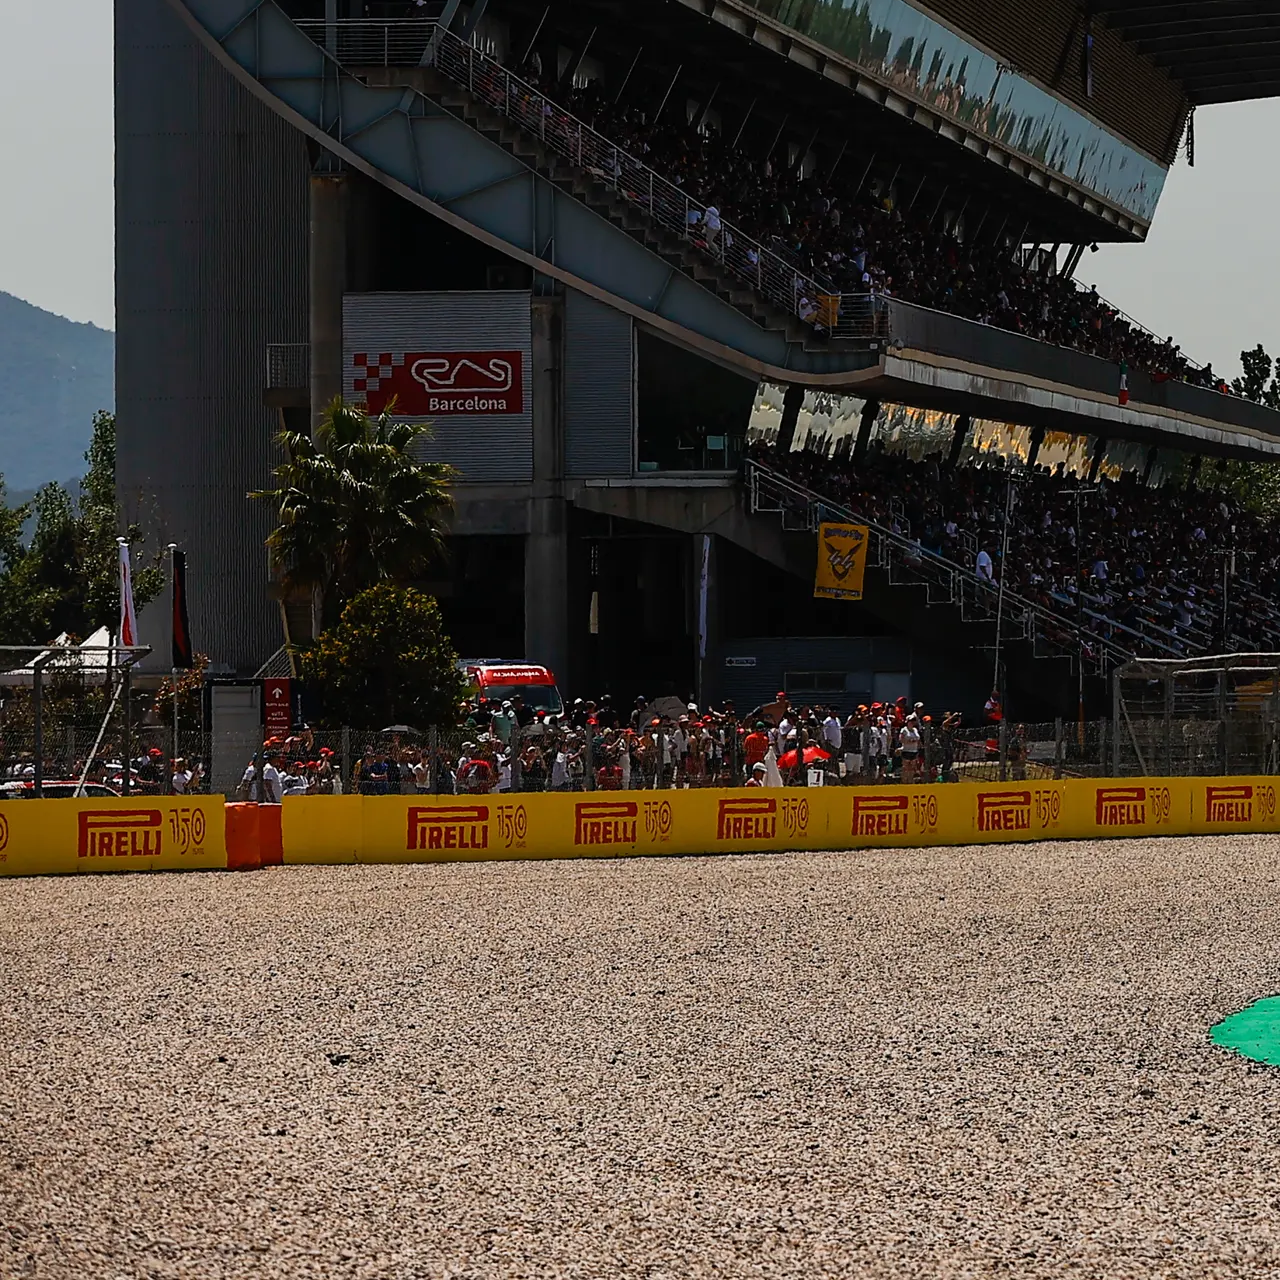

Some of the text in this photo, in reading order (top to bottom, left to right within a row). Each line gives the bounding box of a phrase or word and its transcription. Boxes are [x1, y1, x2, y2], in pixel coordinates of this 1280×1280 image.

[428, 395, 507, 411] Barcelona
[575, 802, 638, 845] PIRELLI
[717, 798, 777, 840] PIRELLI
[852, 796, 908, 837] PIRELLI
[973, 791, 1031, 832] PIRELLI
[1096, 788, 1146, 826] PIRELLI
[1206, 786, 1253, 822] PIRELLI
[78, 810, 162, 857] PIRELLI
[407, 806, 489, 849] PIRELLI
